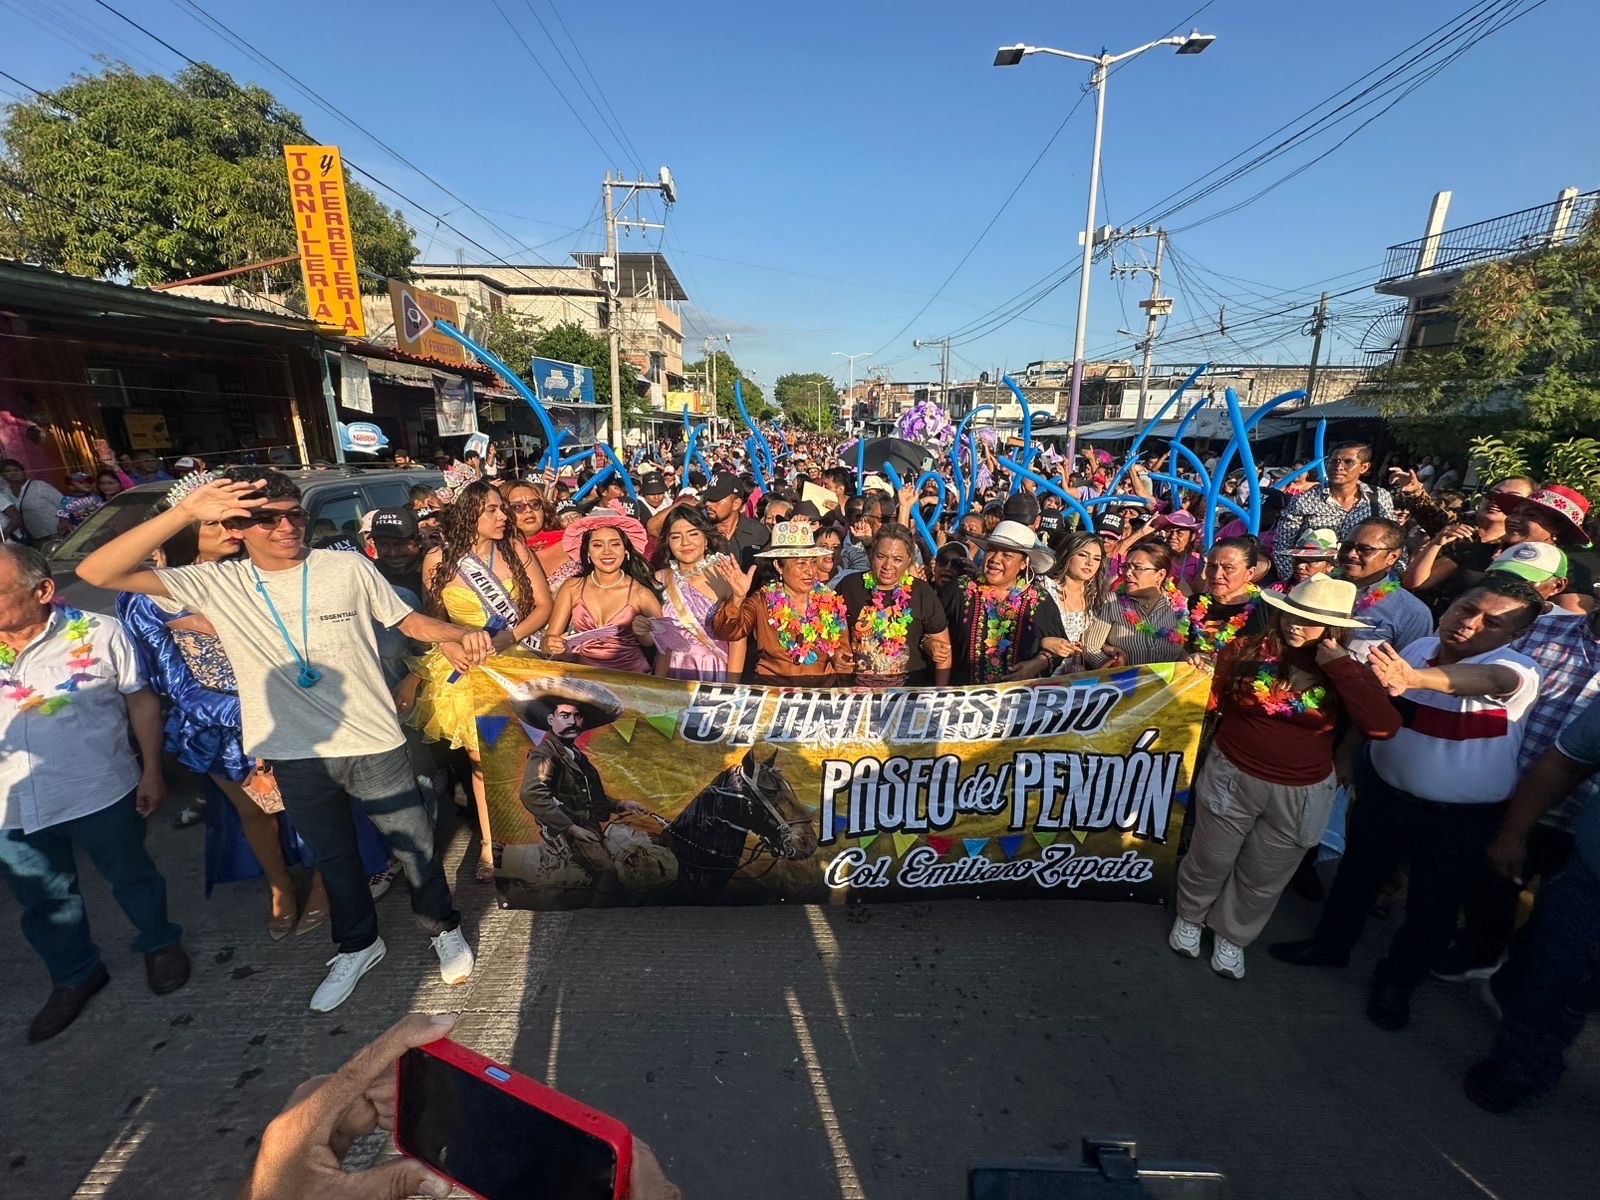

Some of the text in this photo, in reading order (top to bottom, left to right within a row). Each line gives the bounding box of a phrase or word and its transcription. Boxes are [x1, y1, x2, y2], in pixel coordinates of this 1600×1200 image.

[289, 152, 332, 318] TORNILLERIA
[319, 180, 359, 330] FERRETERIA
[471, 571, 499, 602] REINA
[495, 600, 509, 616] DE
[764, 684, 1123, 743] ANIVERSARIO
[819, 728, 1183, 845] PASEO del PENDÓN
[825, 845, 1153, 888] Col. Emiliano Zapata
